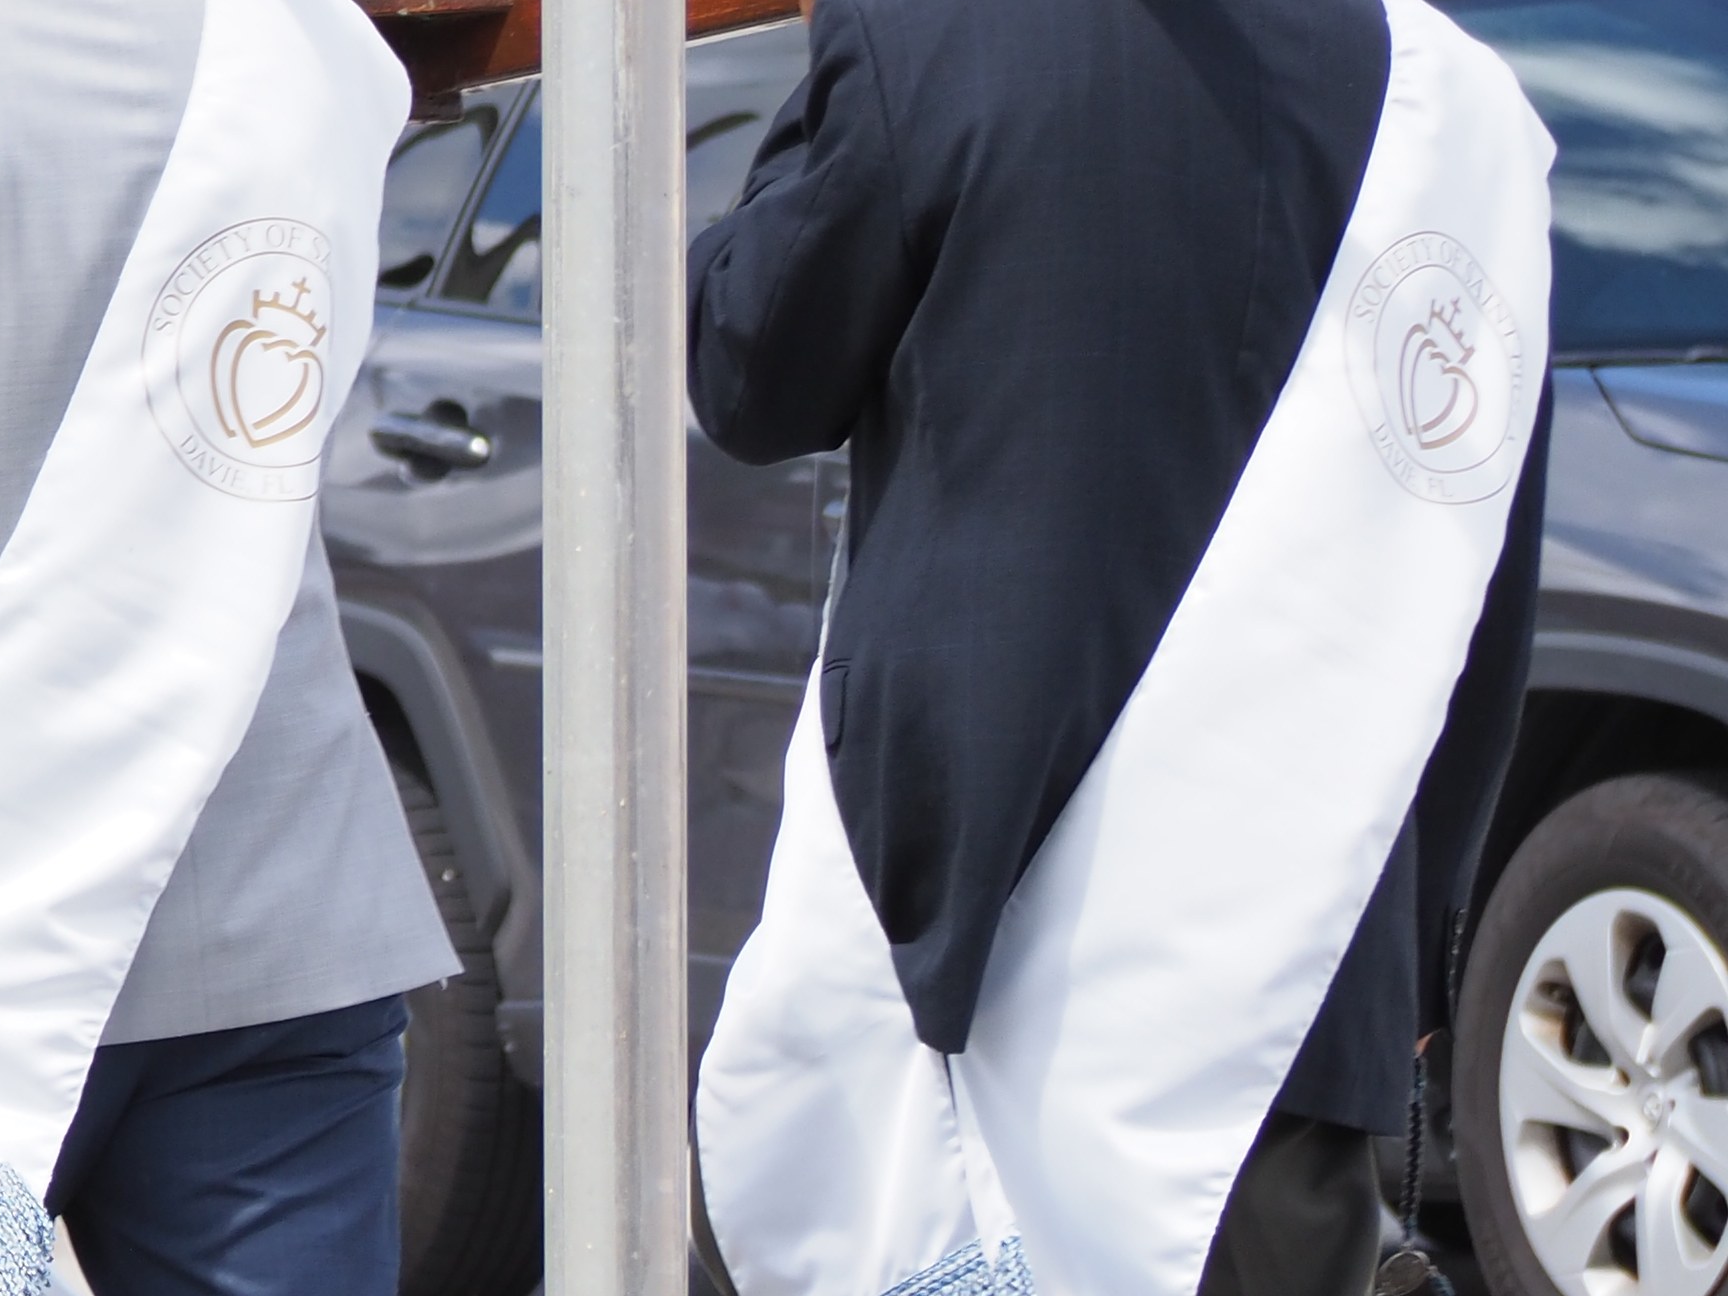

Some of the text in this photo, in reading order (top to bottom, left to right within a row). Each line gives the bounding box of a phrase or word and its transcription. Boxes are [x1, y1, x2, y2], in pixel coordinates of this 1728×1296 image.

[152, 226, 252, 337] SOCIETY
[264, 223, 306, 248] OF
[1354, 237, 1435, 325] SOCIETY
[1440, 240, 1461, 265] OF
